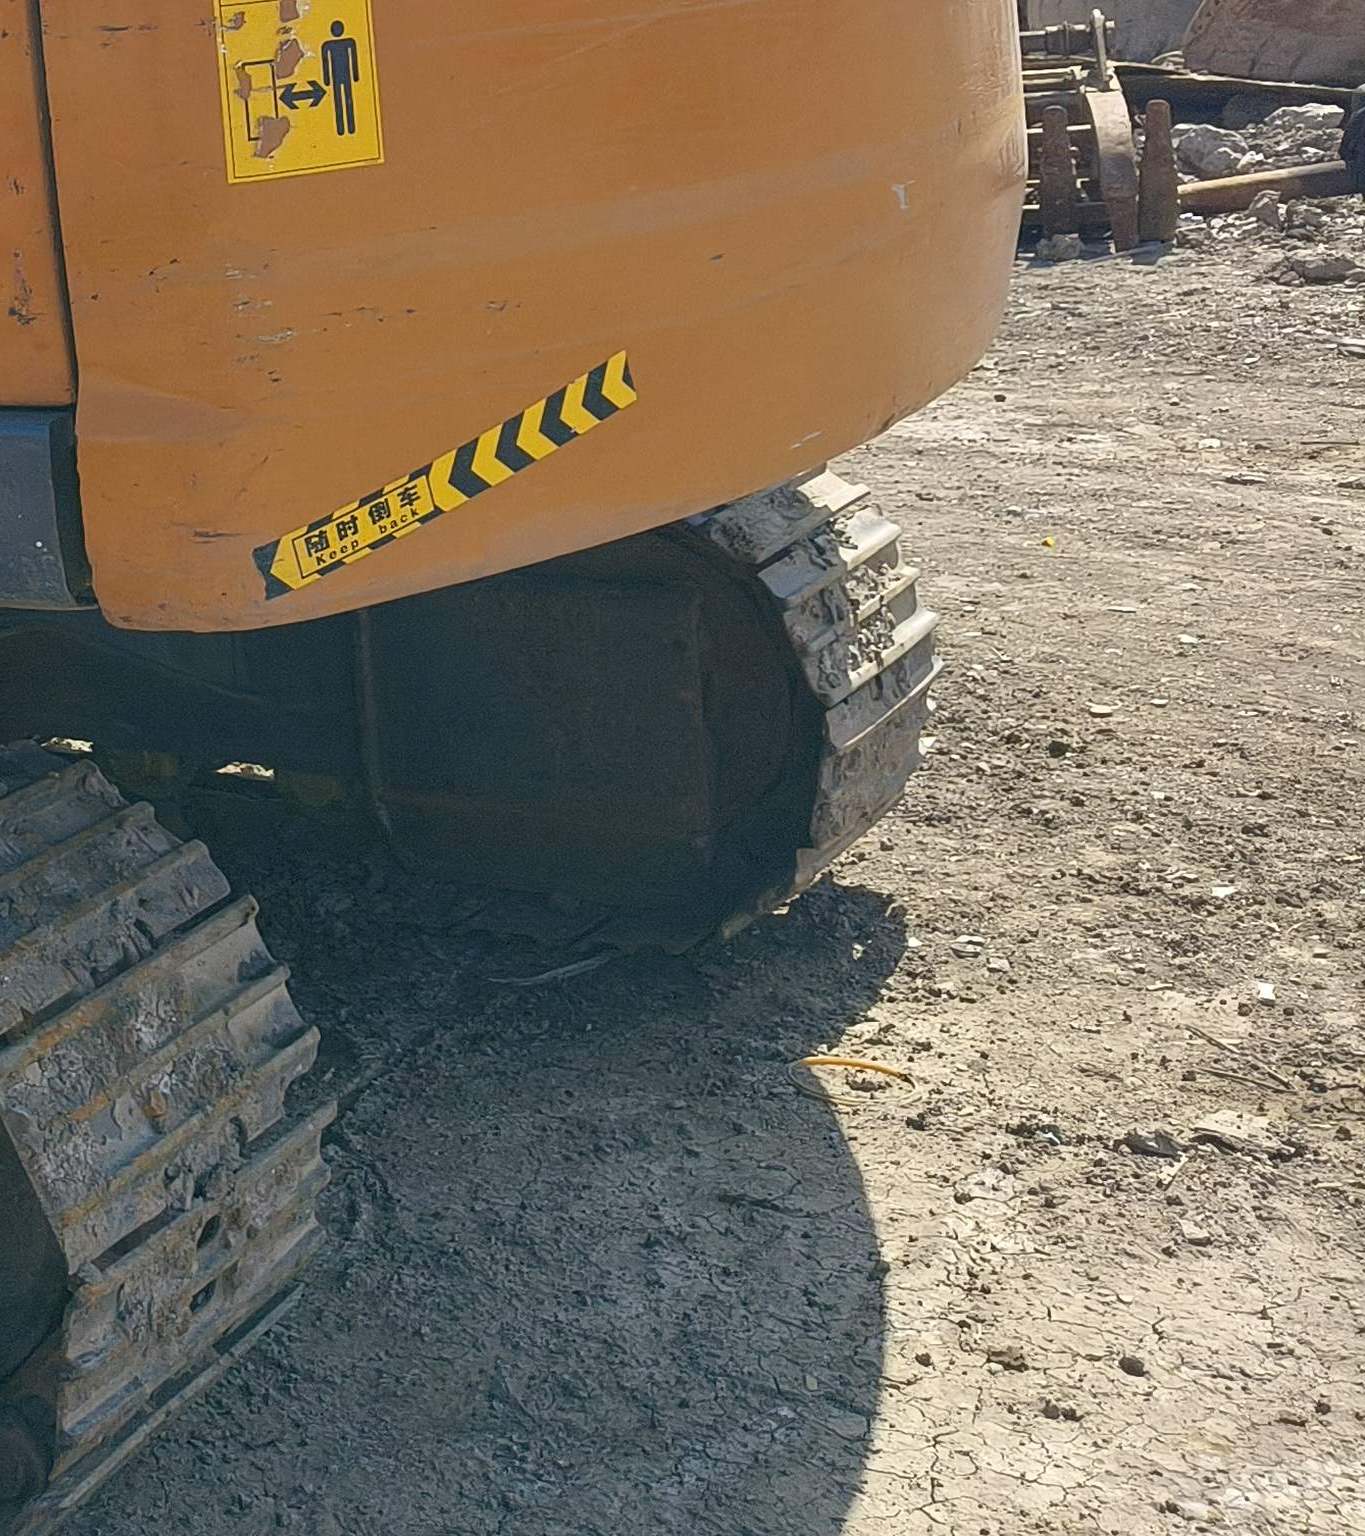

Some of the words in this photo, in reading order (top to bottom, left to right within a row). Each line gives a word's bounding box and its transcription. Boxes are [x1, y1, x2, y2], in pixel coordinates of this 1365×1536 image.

[304, 484, 421, 558] 随时倒车
[315, 539, 359, 566] Keep
[378, 508, 419, 534] back
